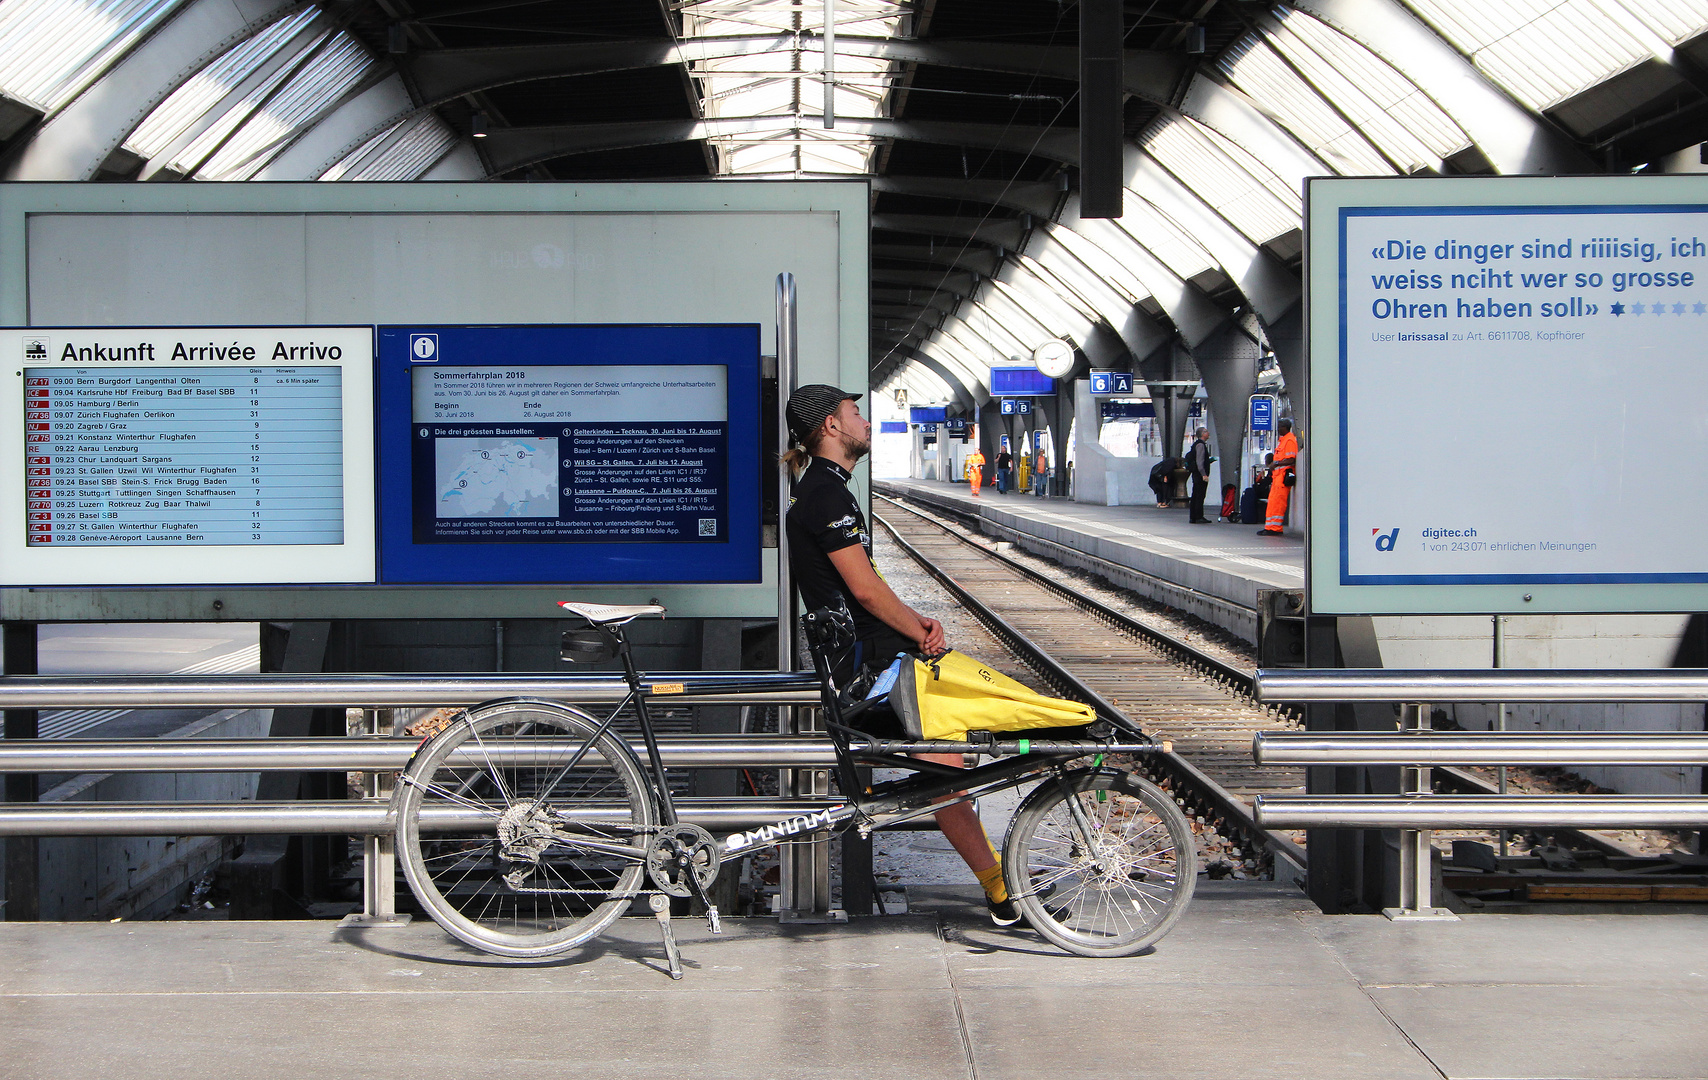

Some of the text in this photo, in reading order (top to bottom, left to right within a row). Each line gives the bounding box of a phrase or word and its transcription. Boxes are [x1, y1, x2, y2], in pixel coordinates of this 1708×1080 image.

[1371, 237, 1706, 264] «Die dinger sind riiiisig, ich
[1371, 268, 1694, 292] weiss nciht wer so grosse
[1372, 297, 1598, 319] Ohren haben soll»
[1371, 330, 1585, 342] User larissasal zu Art. 6611708, Kopfhörer
[60, 341, 341, 361] Ankunft Arrivée Arrivo
[433, 371, 502, 380] Sommerfahrplan
[135, 377, 176, 385] Langenthal
[553, 381, 581, 389] Regionen
[1096, 379, 1106, 391] 6
[1118, 380, 1127, 390] A
[434, 402, 459, 410] Beginn
[1005, 404, 1012, 412] 6
[102, 411, 139, 419] Flughafen
[463, 428, 493, 436] grössten
[159, 433, 196, 441] Flughafen
[100, 456, 137, 464] Landquart
[141, 455, 172, 464] Sargans
[200, 466, 236, 474] Flughafen
[1422, 527, 1476, 539] digitec.ch
[79, 534, 141, 542] Genève-Aéroport
[1421, 542, 1425, 551] 1
[1490, 541, 1536, 551] ehrlichen
[1539, 541, 1596, 552] Meinungen
